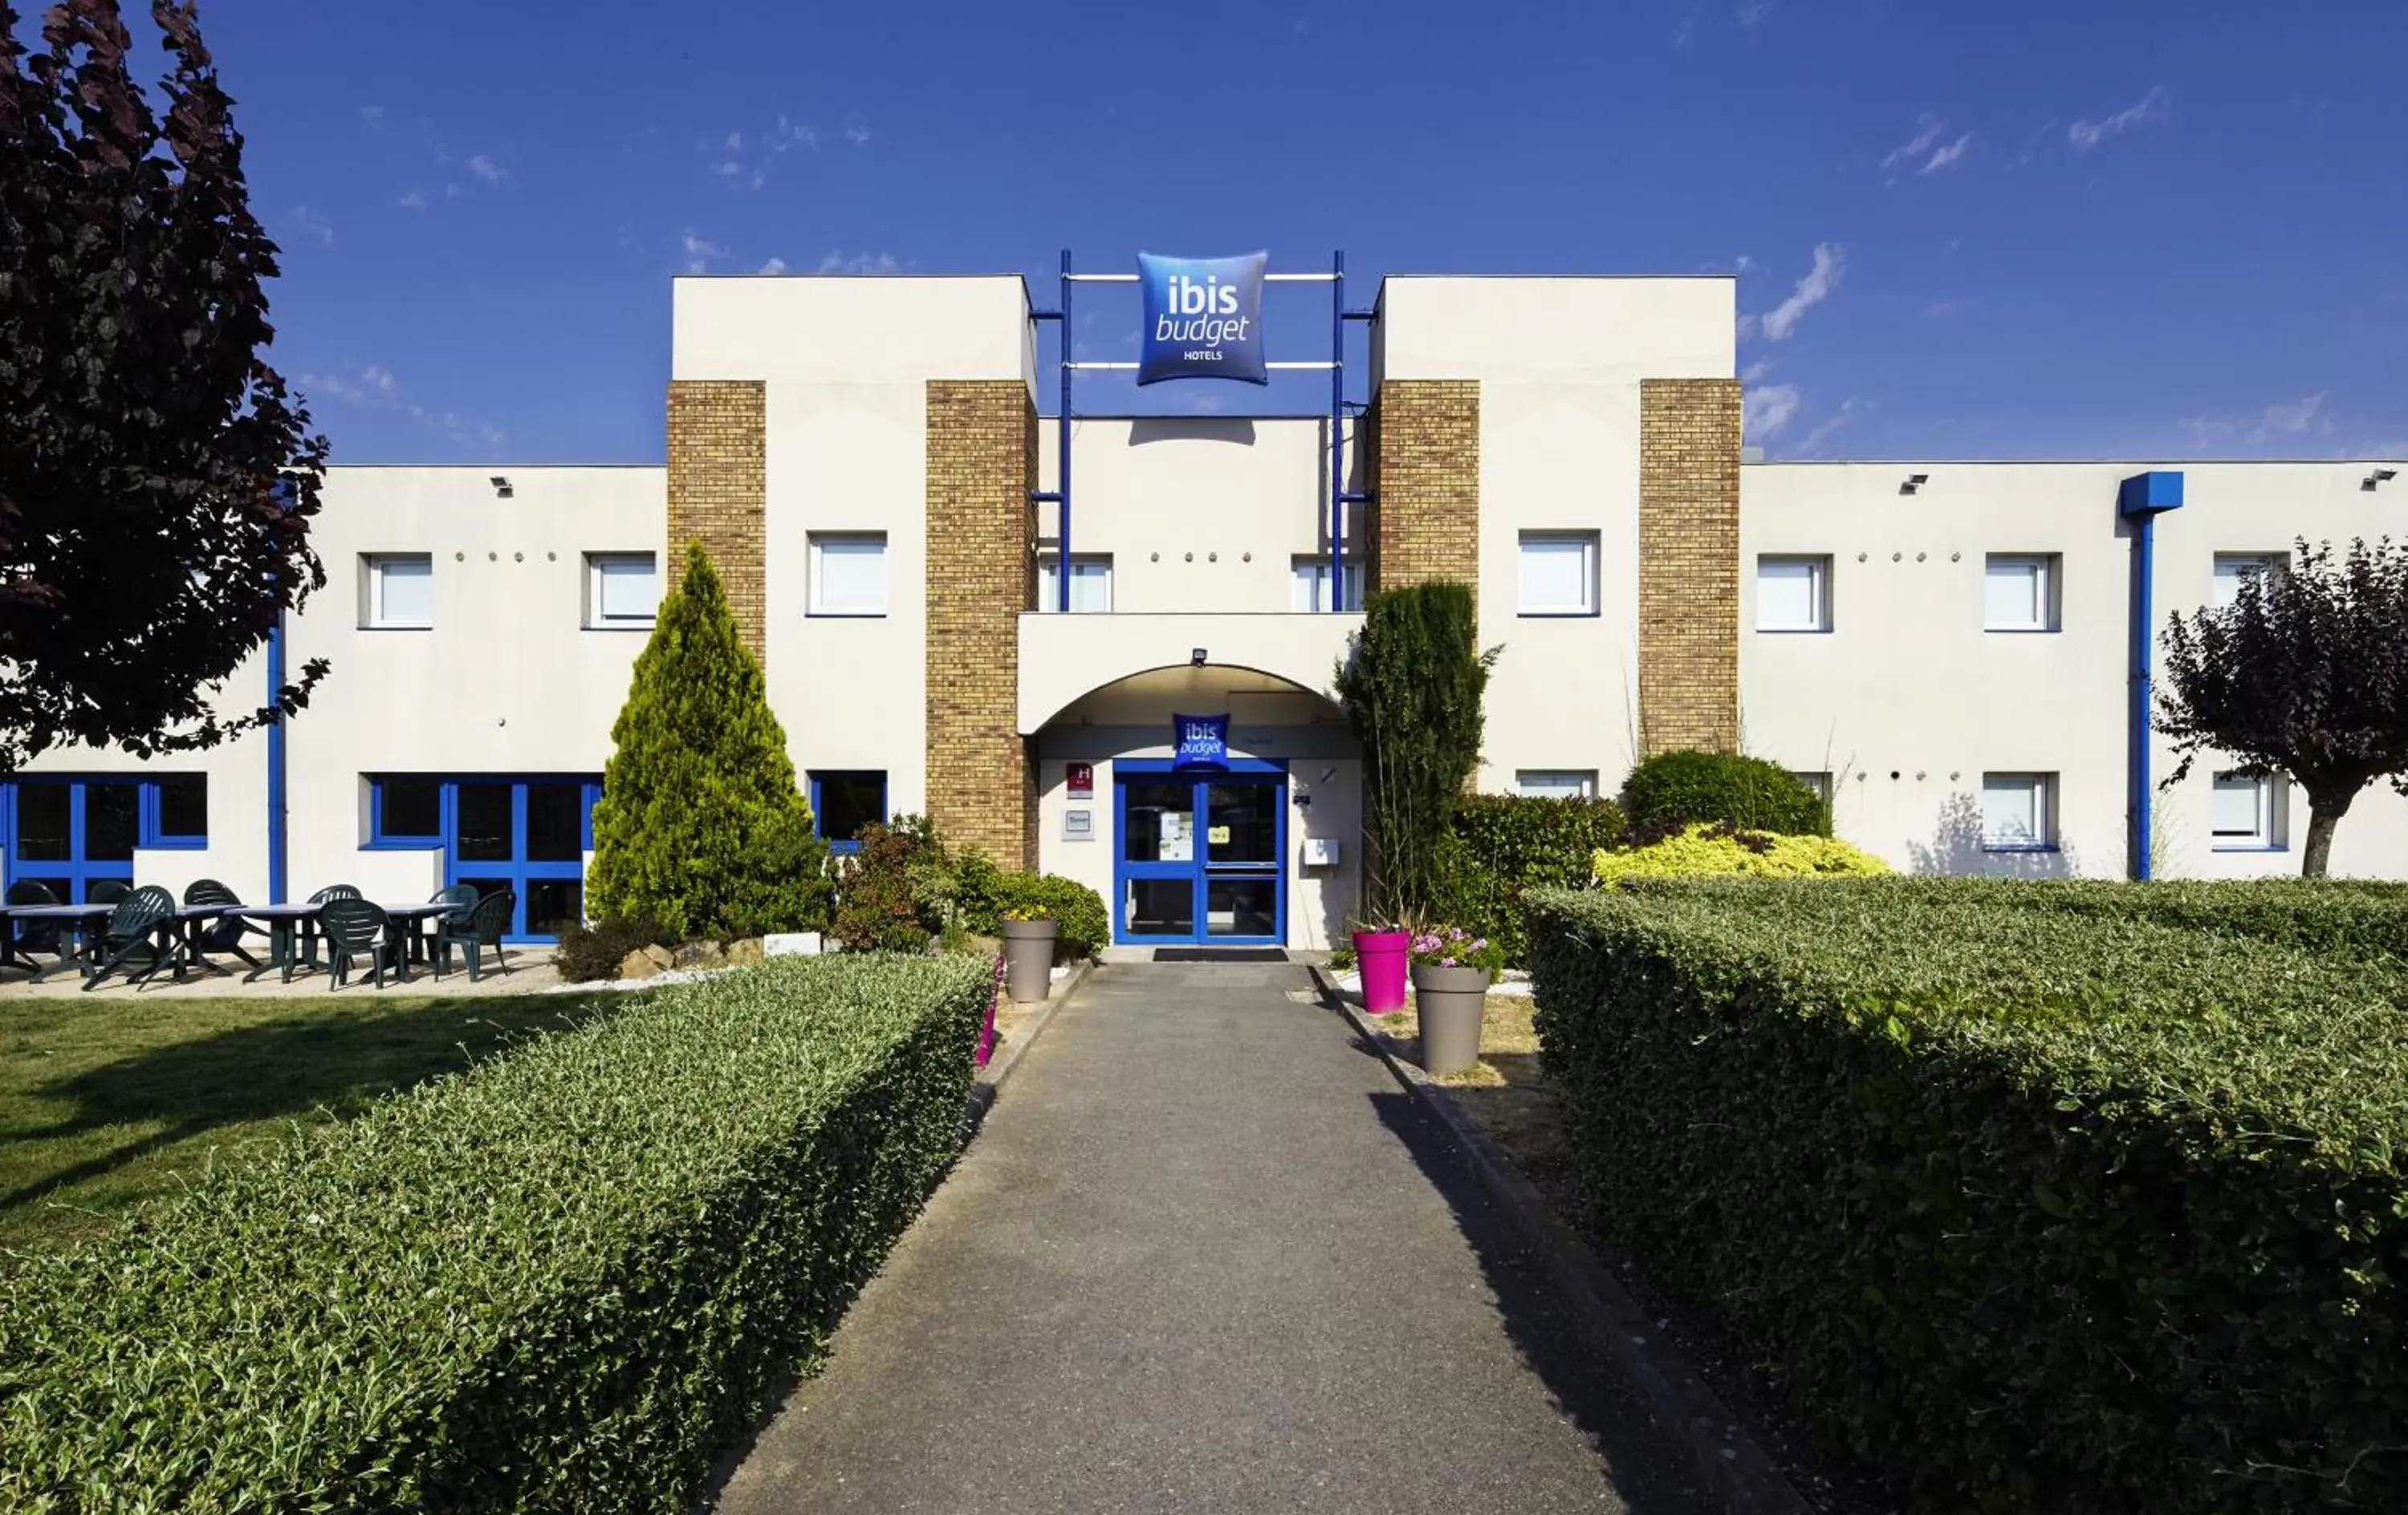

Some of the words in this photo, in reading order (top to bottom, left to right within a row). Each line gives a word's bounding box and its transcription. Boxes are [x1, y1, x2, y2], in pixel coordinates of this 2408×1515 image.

[1169, 275, 1239, 314] ibis
[1156, 314, 1249, 347] budget
[1184, 351, 1223, 360] HOTELS
[1186, 723, 1216, 740] ibis
[1078, 767, 1090, 779] H
